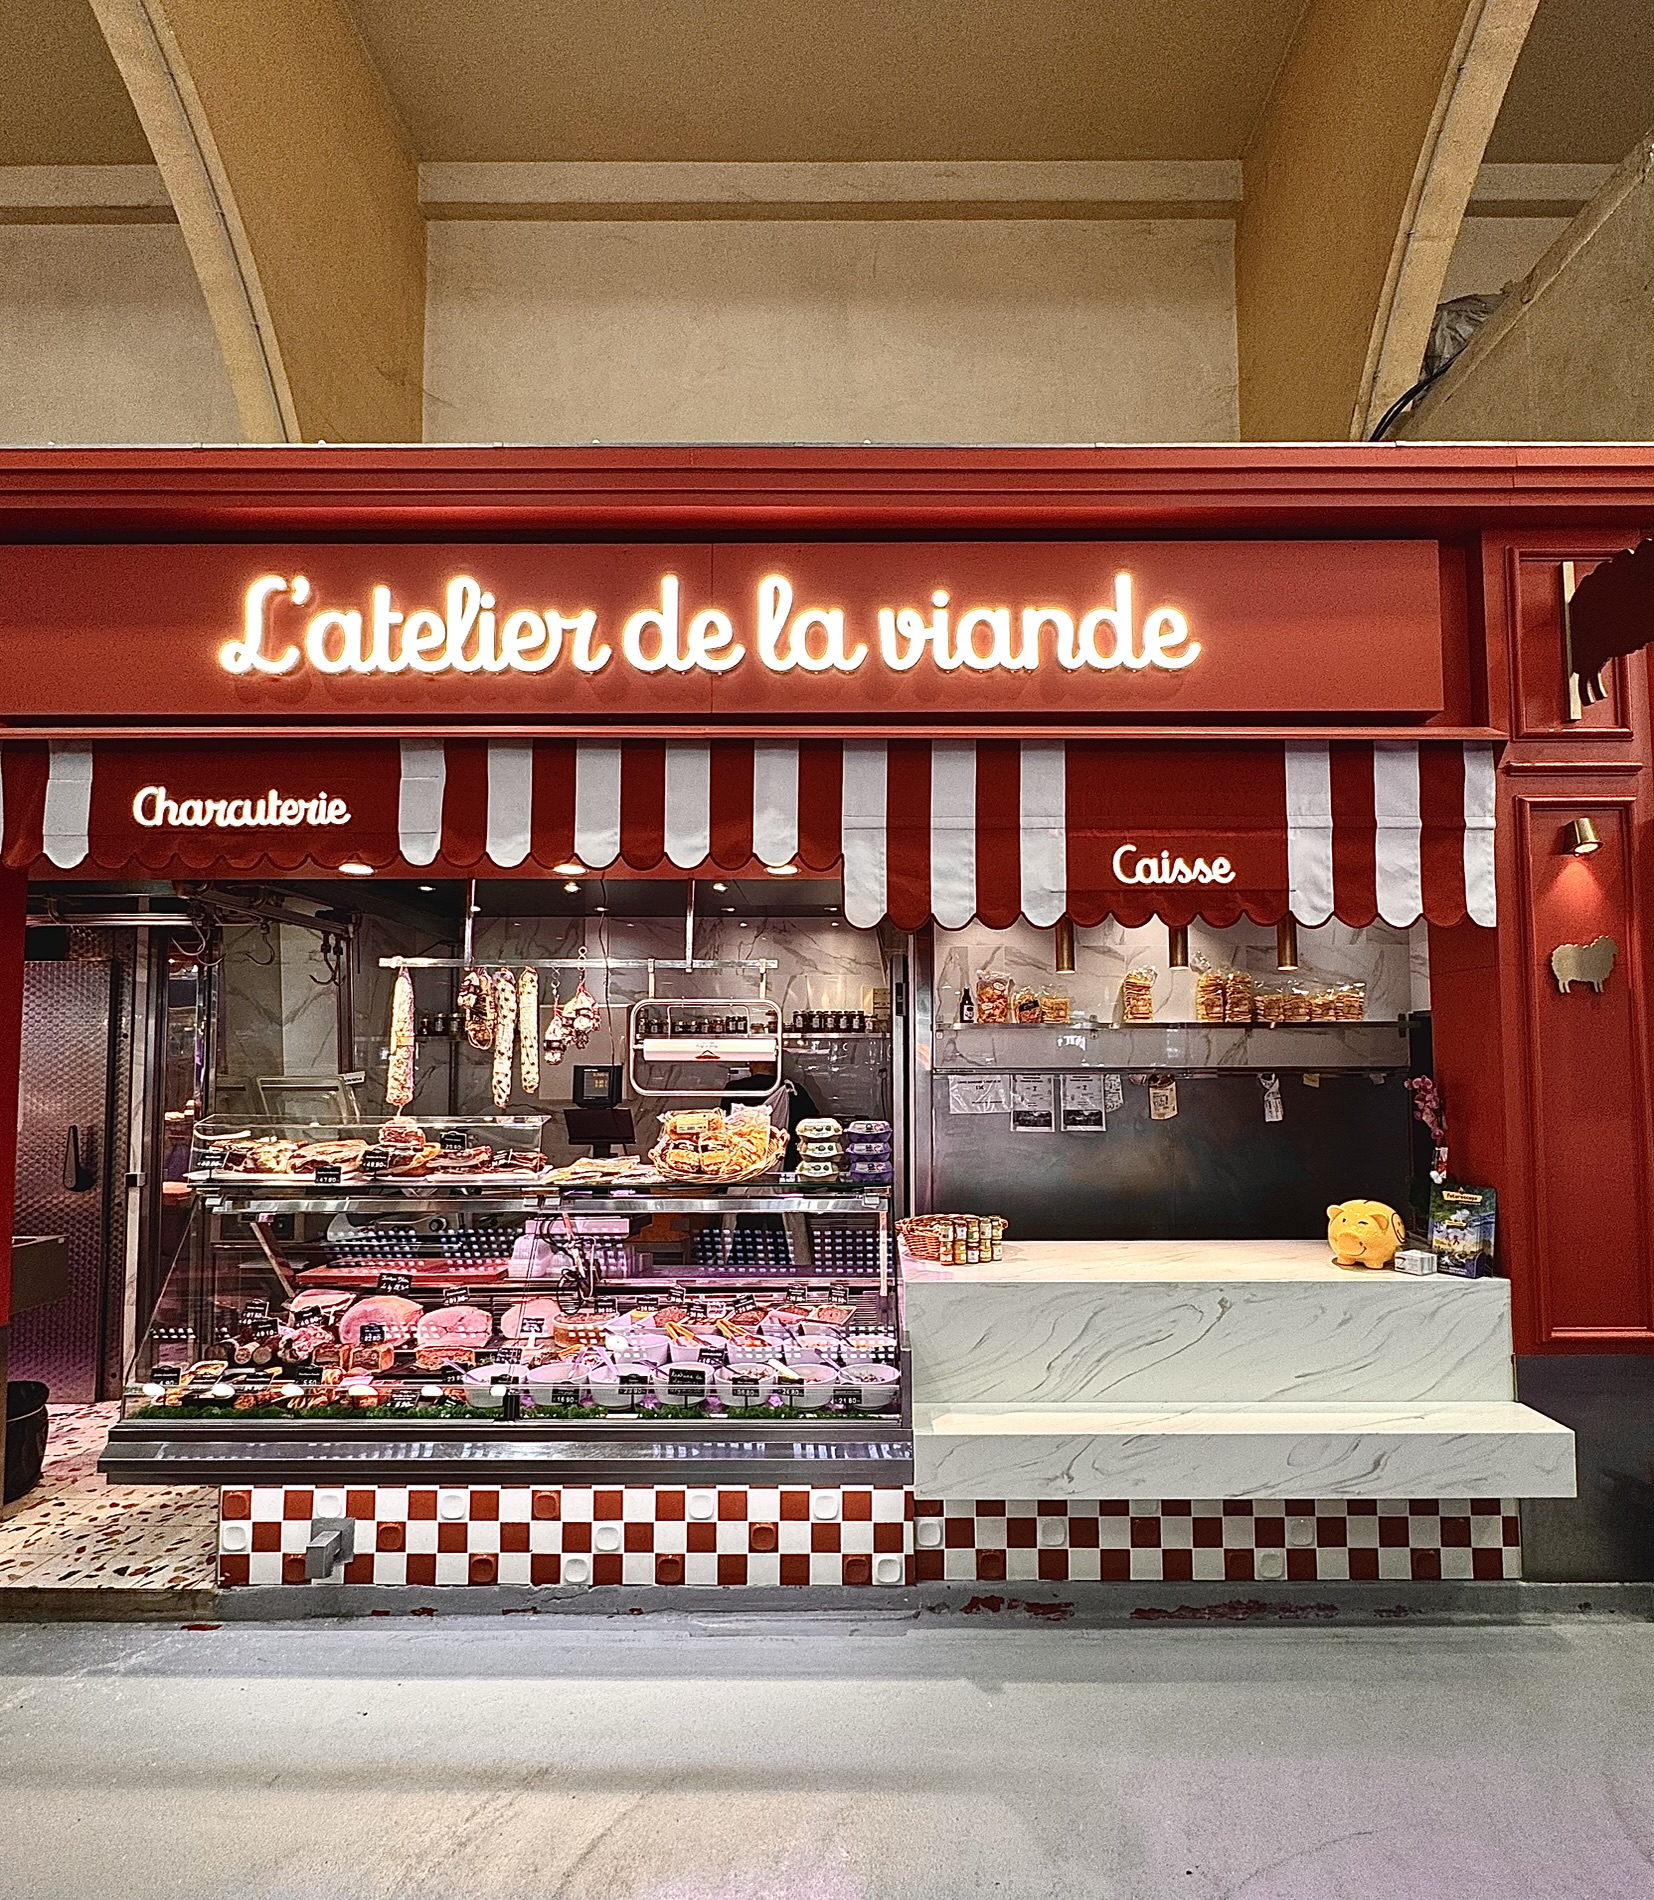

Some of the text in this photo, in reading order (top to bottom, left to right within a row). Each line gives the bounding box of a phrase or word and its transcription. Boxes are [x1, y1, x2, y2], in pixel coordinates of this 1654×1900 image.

[218, 573, 1202, 674] L'atelier de la viande
[132, 786, 352, 827] Charcuterie
[1112, 844, 1237, 884] Caisse
